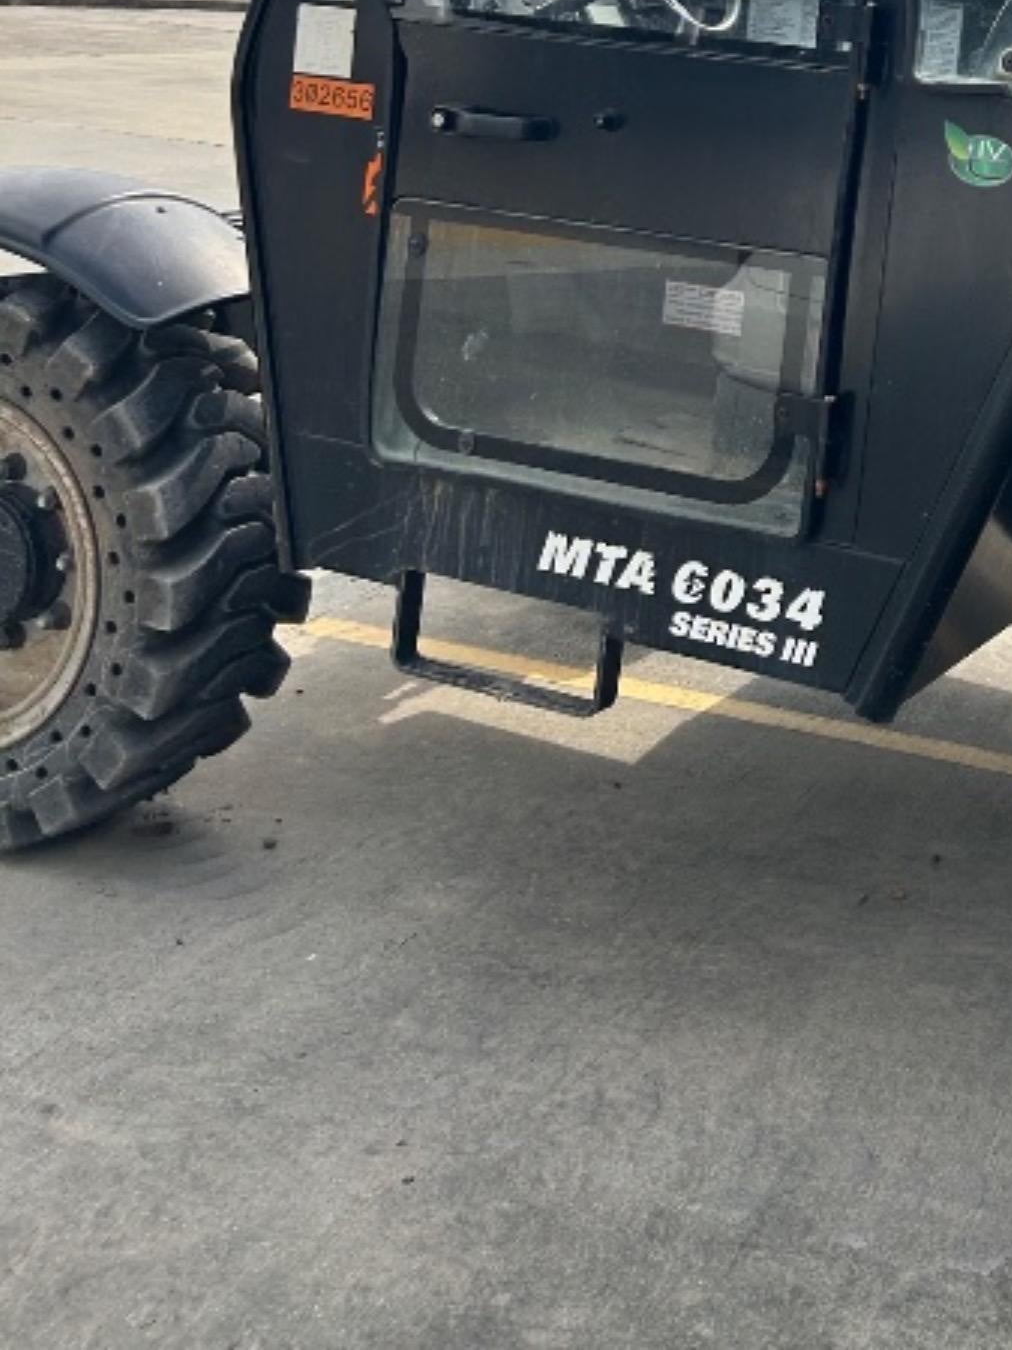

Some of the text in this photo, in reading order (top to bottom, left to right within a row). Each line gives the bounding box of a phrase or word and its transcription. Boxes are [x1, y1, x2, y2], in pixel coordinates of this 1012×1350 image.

[536, 530, 656, 595] MTA
[668, 611, 819, 667] SERIES III
